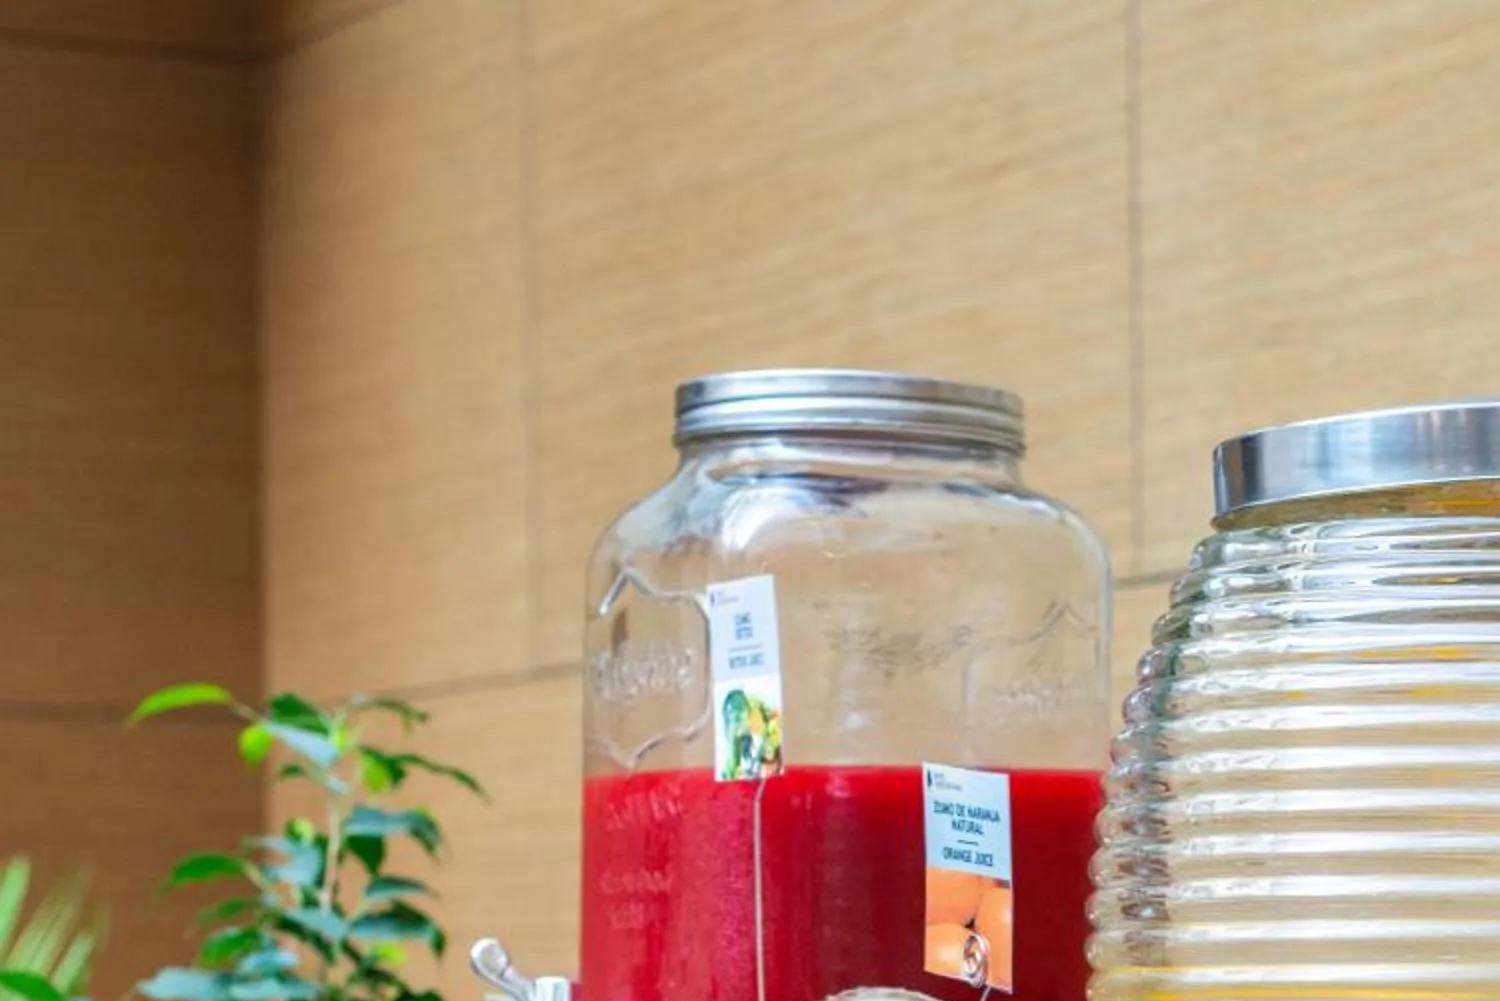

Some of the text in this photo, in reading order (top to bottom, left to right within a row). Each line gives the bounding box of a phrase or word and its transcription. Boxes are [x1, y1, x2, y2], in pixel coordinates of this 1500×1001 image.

[933, 800, 1001, 822] ZUMO DE NARANJA
[952, 819, 984, 835] NATURAL
[943, 846, 993, 867] ORANGE JUICE
